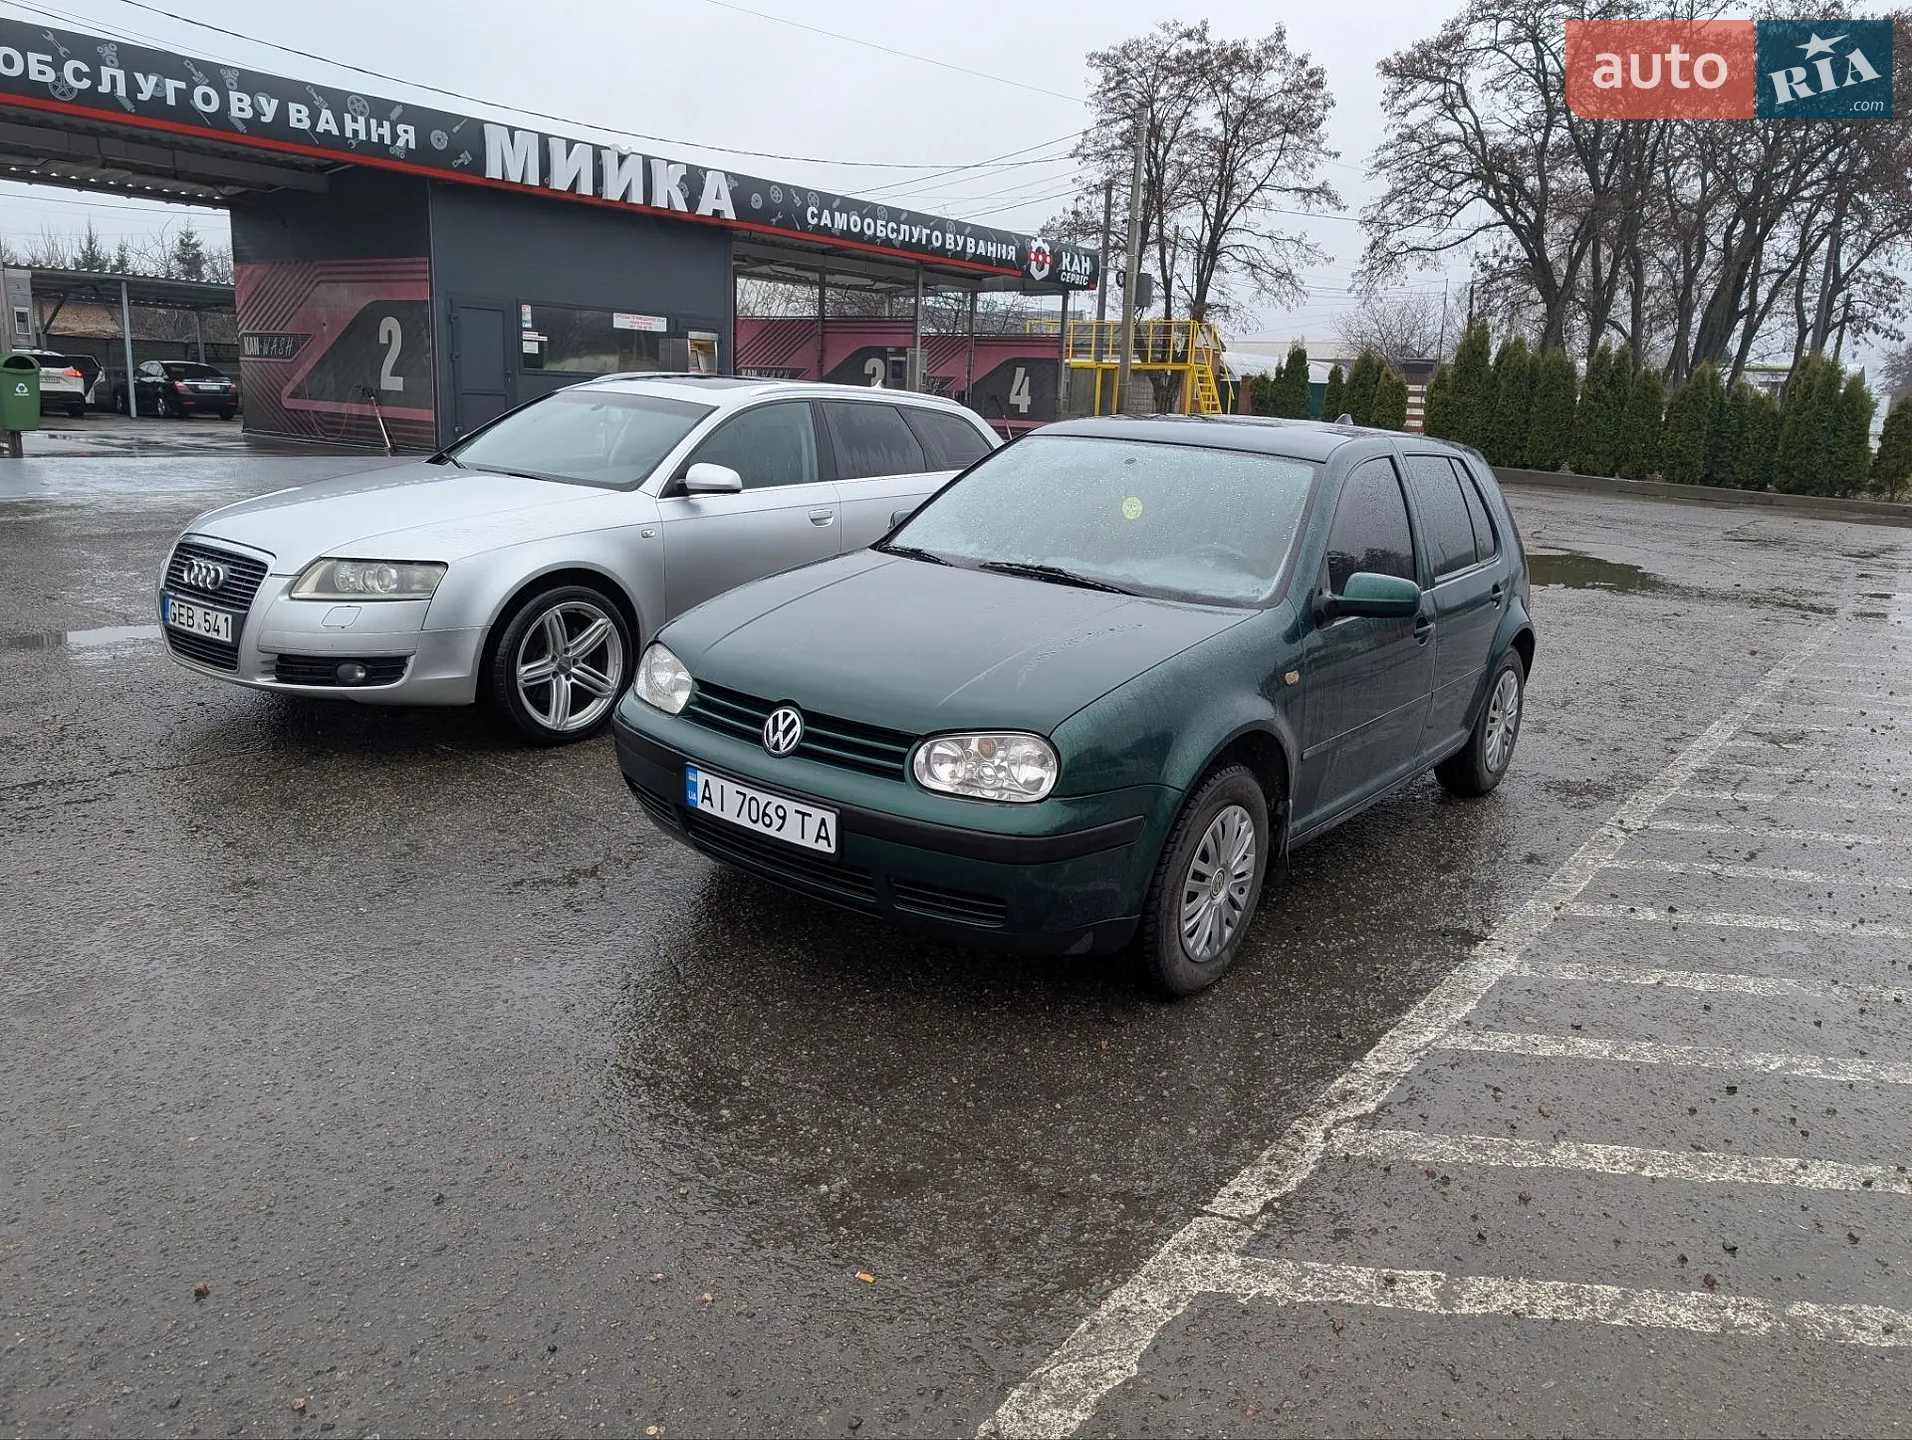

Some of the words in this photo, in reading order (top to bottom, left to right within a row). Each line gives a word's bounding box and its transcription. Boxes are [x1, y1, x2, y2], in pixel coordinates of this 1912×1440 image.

[0, 46, 416, 150] ОБСЛУГОВУВАННЯ
[483, 123, 737, 220] МИЙКА
[806, 206, 1016, 261] САМООБСЛУГОВУВАННЯ
[1060, 271, 1089, 286] СЕРВІС
[1061, 251, 1091, 275] КАН
[378, 316, 404, 391] 2
[1009, 367, 1032, 413] 4
[169, 601, 195, 629] GEB
[203, 611, 230, 639] 541
[700, 779, 725, 812] AI
[735, 790, 788, 832] 7069
[794, 809, 832, 848] TA
